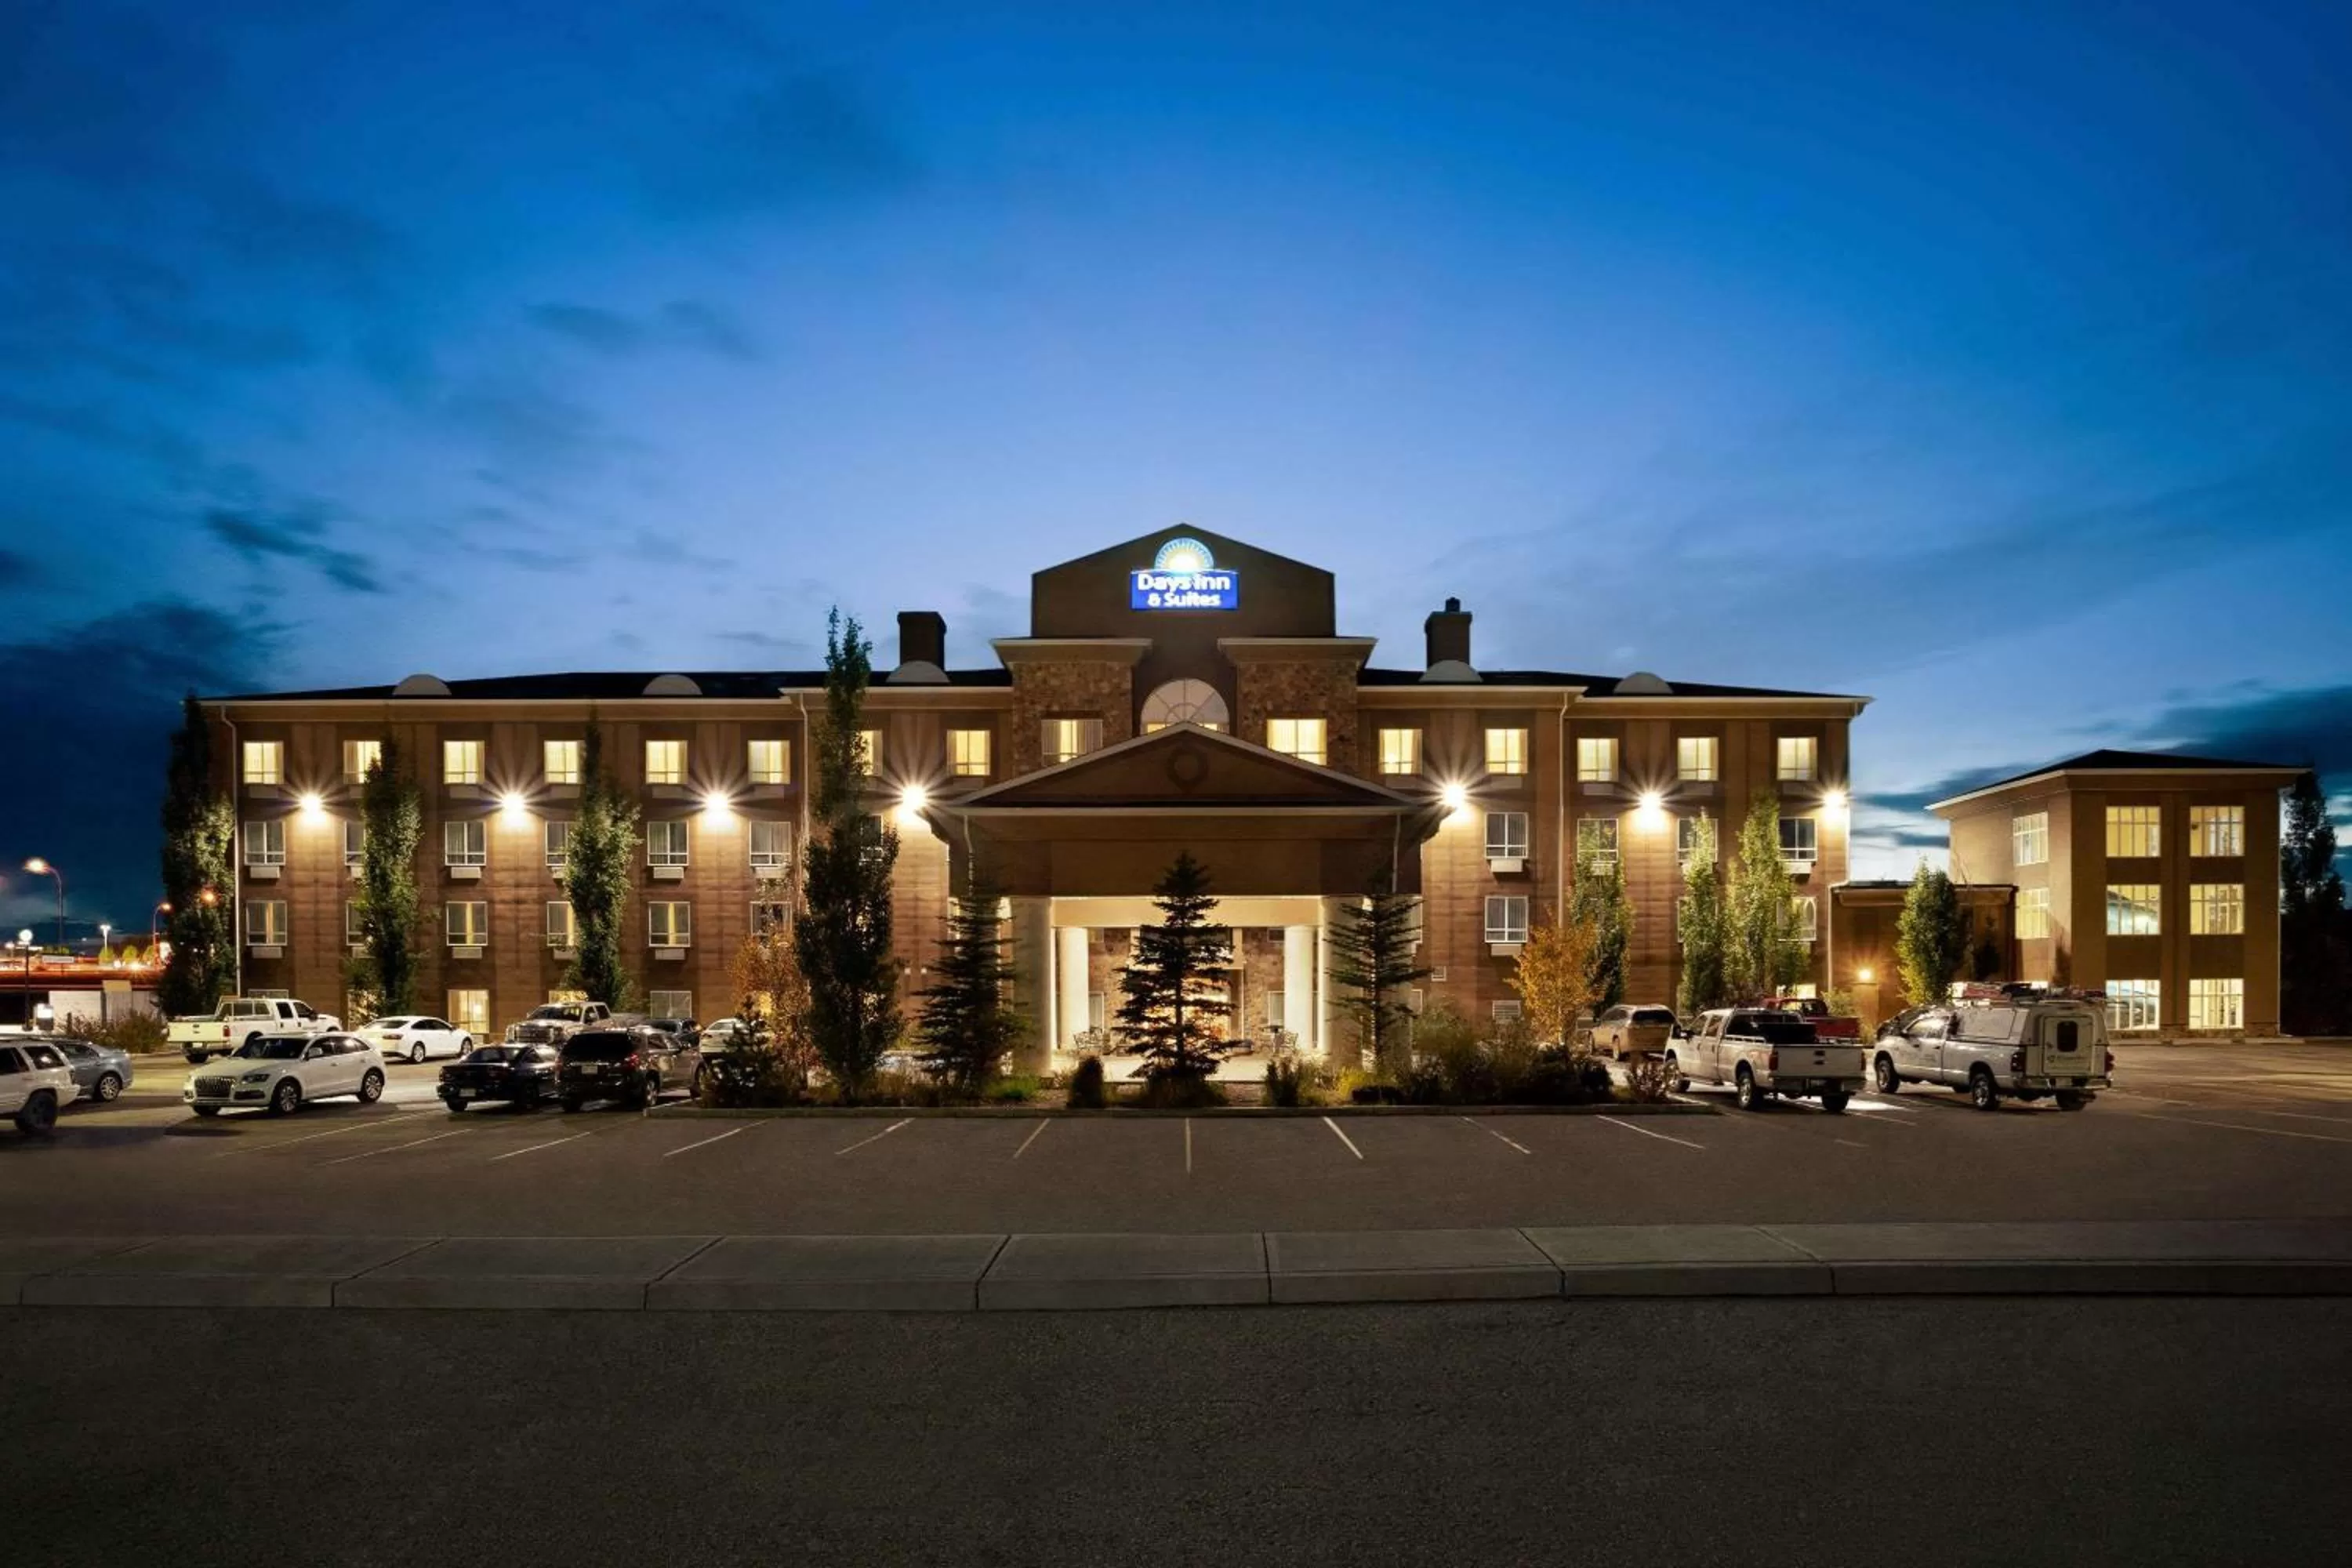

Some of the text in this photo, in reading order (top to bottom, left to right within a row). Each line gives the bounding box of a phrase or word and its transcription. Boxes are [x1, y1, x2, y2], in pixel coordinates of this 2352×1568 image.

[1138, 574, 1230, 593] Days Inn
[1148, 592, 1221, 607] & Suites
